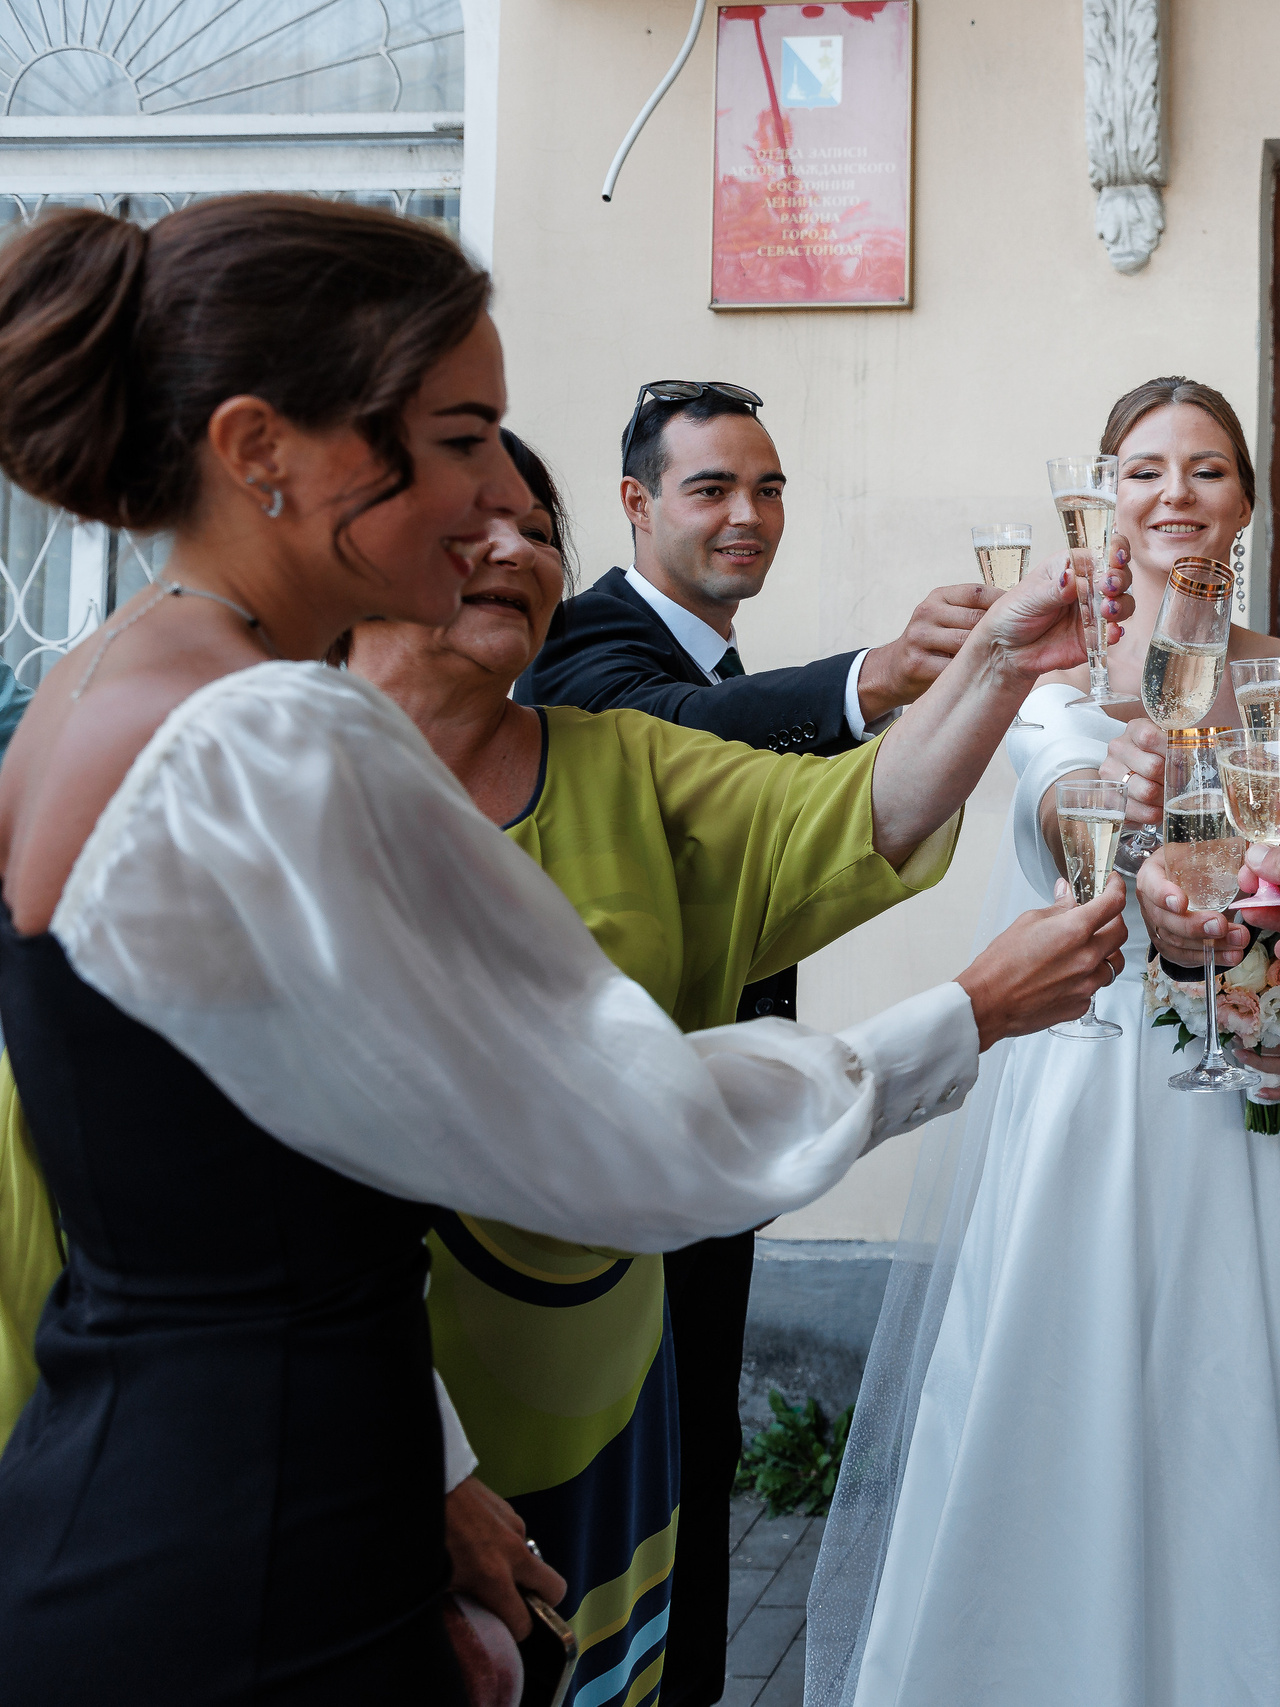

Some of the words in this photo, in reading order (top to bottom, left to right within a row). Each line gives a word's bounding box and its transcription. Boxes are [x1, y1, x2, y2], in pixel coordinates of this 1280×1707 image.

[809, 146, 867, 159] ЗАПИСИ
[730, 164, 775, 177] АКТОВ
[780, 162, 896, 176] ГРАЖДАНСКОГО
[767, 179, 856, 192] СОСТОЯНИЯ
[762, 195, 860, 208] ЛЕНИНСКОГО
[780, 212, 840, 224] РАЙОНА
[781, 228, 838, 241] ГОРОДА
[757, 244, 863, 257] СЕВАСТОПОЛЯ
